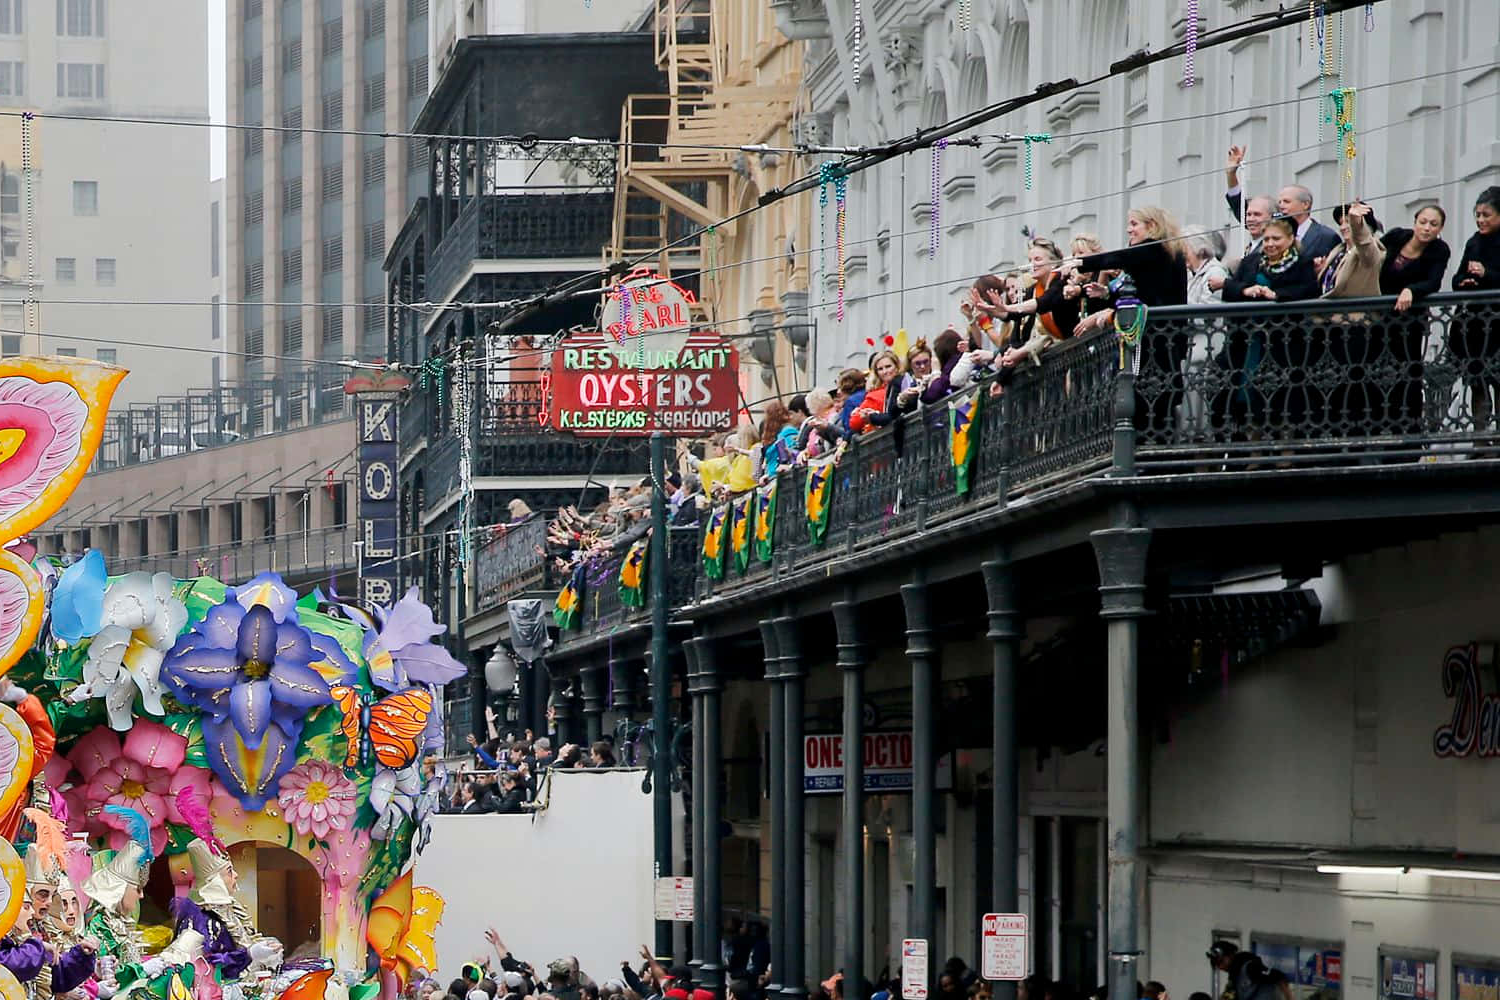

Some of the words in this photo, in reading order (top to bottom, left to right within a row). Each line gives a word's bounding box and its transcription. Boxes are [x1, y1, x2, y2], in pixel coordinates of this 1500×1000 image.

[563, 348, 732, 370] RESTAURANT
[579, 373, 712, 407] OYSTERS
[806, 735, 844, 769] ONE
[863, 733, 913, 769] OCTO
